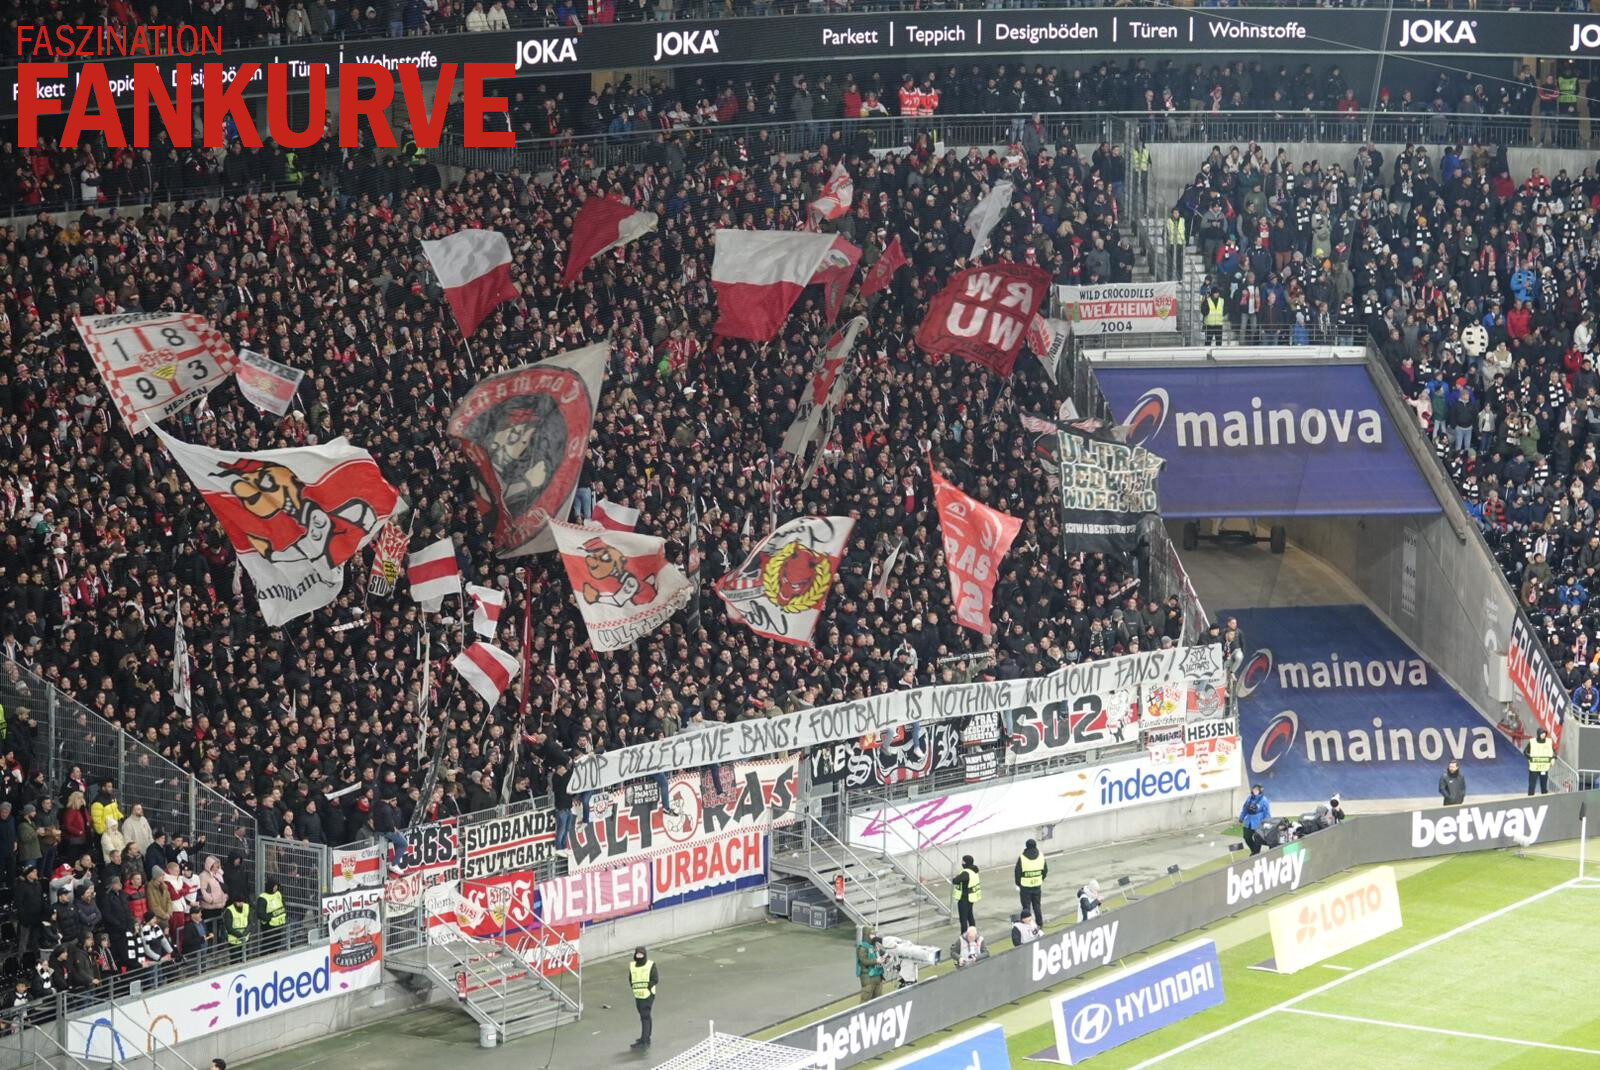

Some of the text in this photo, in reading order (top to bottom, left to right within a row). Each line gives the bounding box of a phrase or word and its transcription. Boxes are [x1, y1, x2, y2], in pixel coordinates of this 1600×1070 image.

[515, 37, 578, 70] JOKA
[654, 30, 719, 61] JOKA
[822, 20, 1306, 46] Parkett Teppich Designböden Türen Wohnstoffe
[1400, 19, 1477, 47] JOKA
[1079, 288, 1154, 300] WILD CROCODILES
[1079, 302, 1153, 318] WELZHEIM
[1101, 321, 1133, 332] 2004
[163, 386, 208, 416] HESSEN
[1175, 397, 1382, 448] mainova
[1278, 653, 1428, 689] mainova
[1508, 616, 1566, 745] ERLENSEE
[571, 650, 1177, 791] STOP COLLECTIVE BANS! FOOTBALL IS NOTHING WITHOUT FANS!
[1187, 721, 1234, 741] HESSEN
[1305, 717, 1497, 763] mainova
[467, 810, 555, 850] SÜDBANDE
[1411, 805, 1549, 849] betway
[465, 842, 555, 878] STUTTGART
[655, 832, 761, 894] URBACH
[1227, 848, 1306, 905] betway
[539, 862, 649, 925] WEILER
[1319, 884, 1381, 932] LOTTO
[1032, 920, 1119, 982] betway
[235, 955, 330, 1018] indeed
[1116, 961, 1215, 1026] HYUNDAI
[816, 1000, 913, 1063] betway
